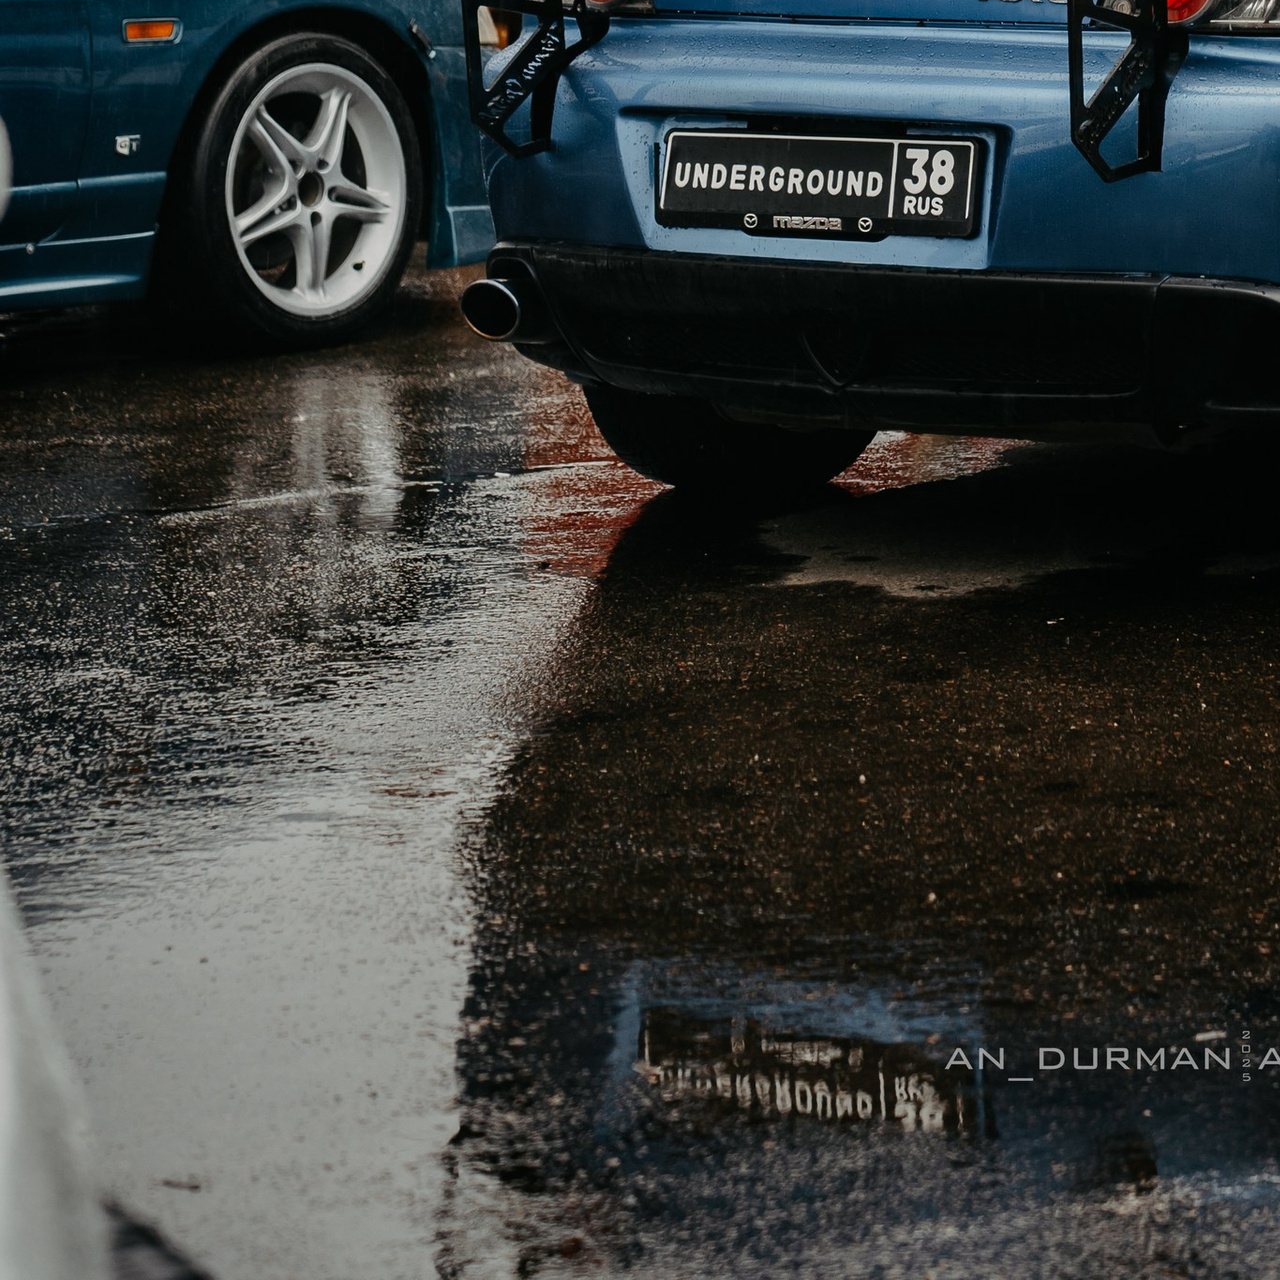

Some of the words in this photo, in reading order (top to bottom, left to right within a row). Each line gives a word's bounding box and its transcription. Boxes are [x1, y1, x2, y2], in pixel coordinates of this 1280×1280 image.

[674, 161, 884, 198] UNDERGROUND
[903, 148, 955, 196] 38
[903, 195, 944, 216] RUS
